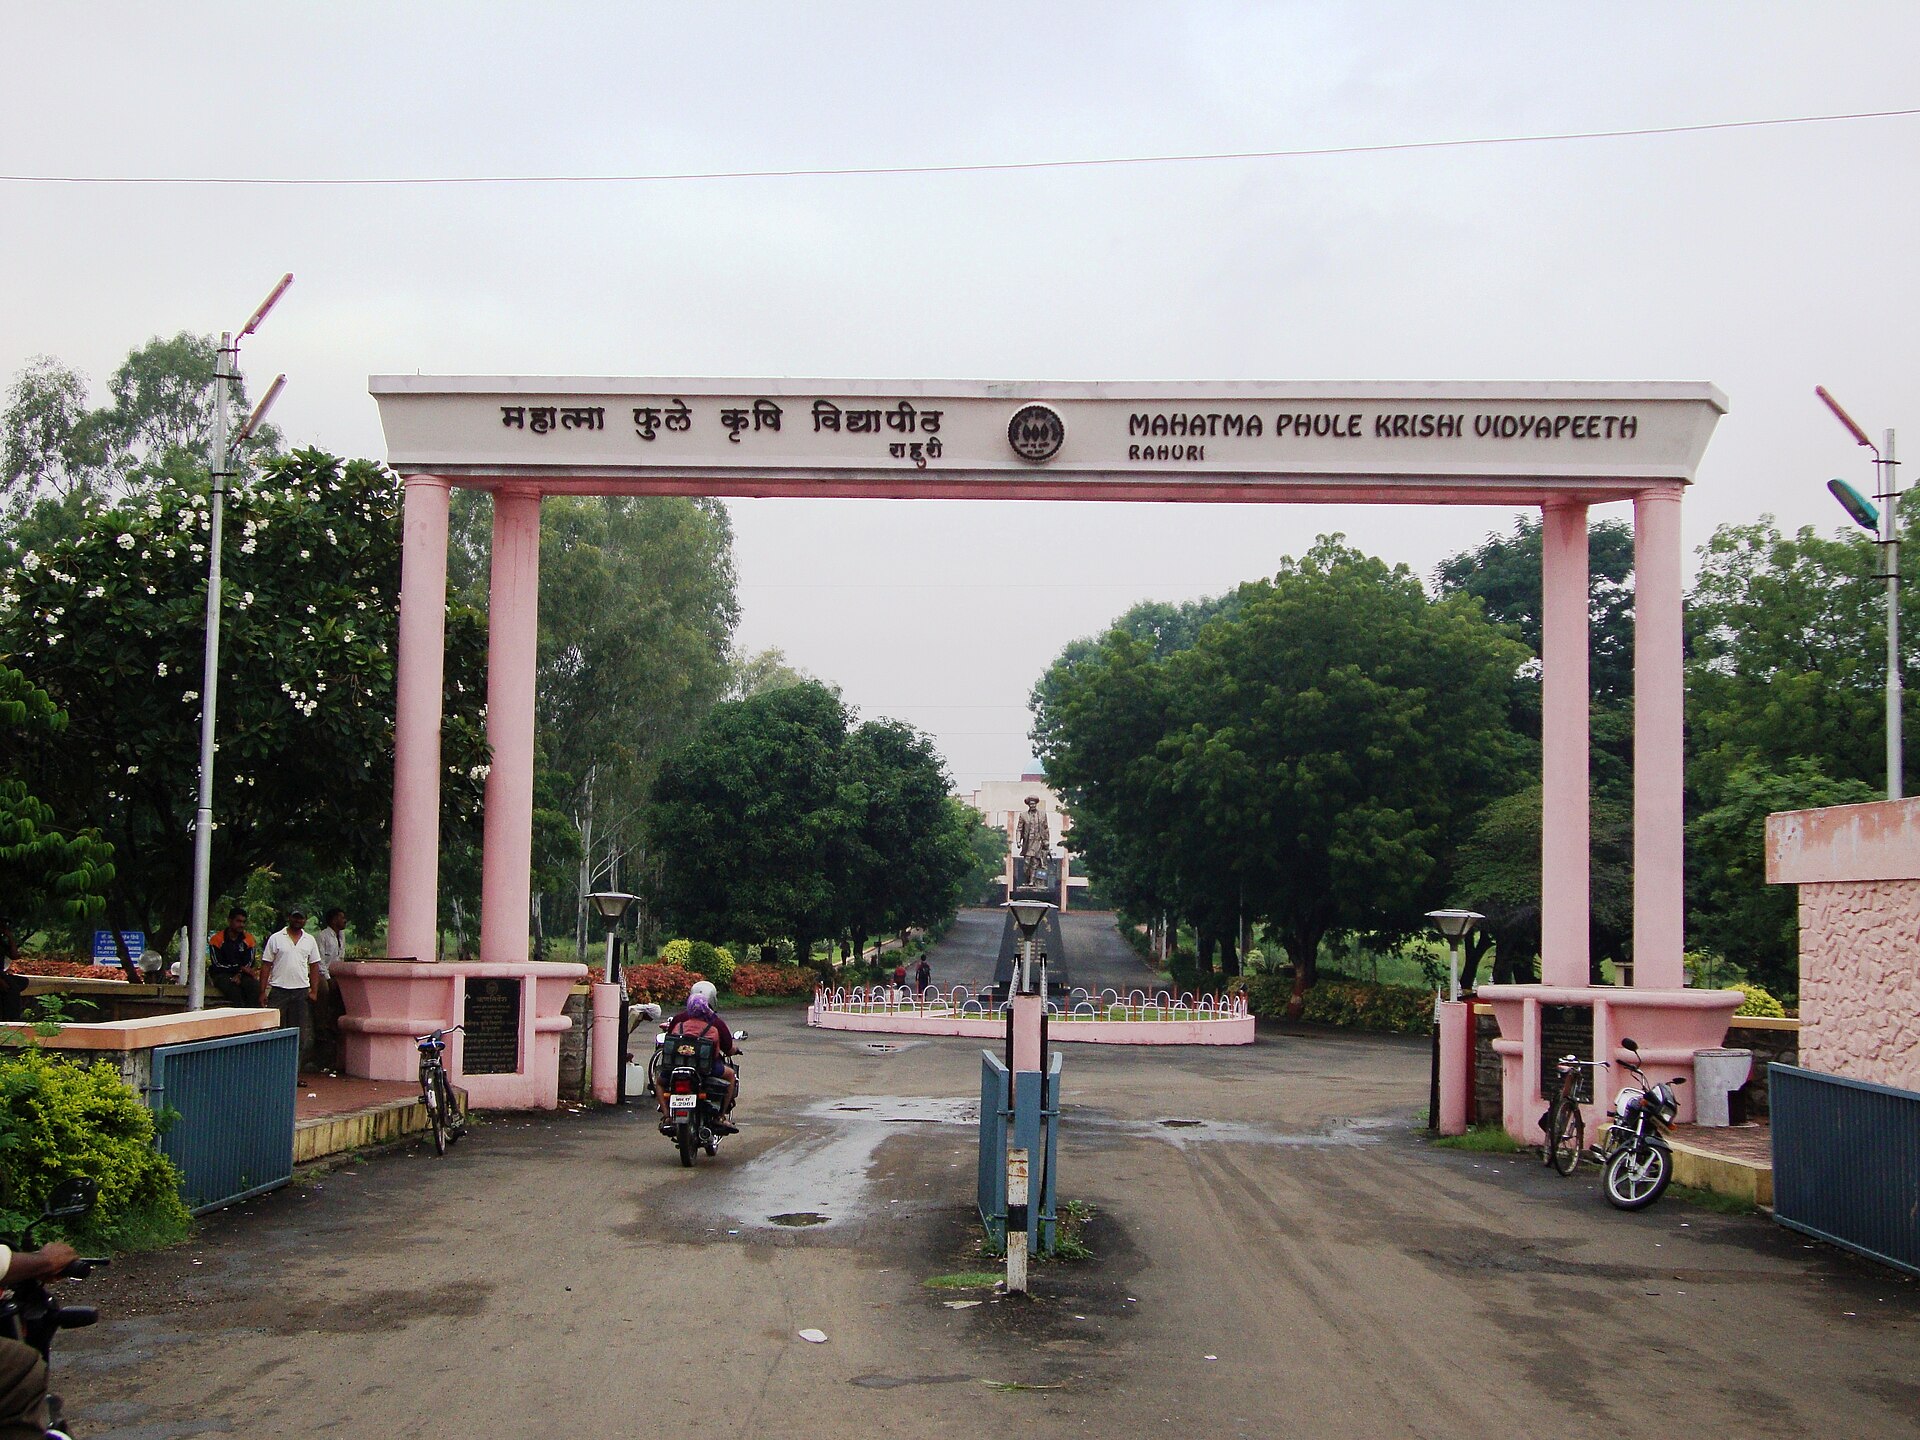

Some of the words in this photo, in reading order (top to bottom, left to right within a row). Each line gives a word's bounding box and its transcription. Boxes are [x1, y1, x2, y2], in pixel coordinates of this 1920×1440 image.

[500, 405, 606, 434] महात्मा
[632, 399, 693, 441] फुले
[720, 399, 784, 443] कृषि
[811, 399, 944, 434] विद्यापीठ
[1129, 413, 1264, 438] MAHATMA
[1276, 413, 1363, 438] PHULE
[1375, 414, 1465, 438] KRISHI
[1474, 414, 1638, 440] VIDYAPEETH
[889, 436, 943, 470] राहुरी
[1128, 444, 1205, 461] RAHURI
